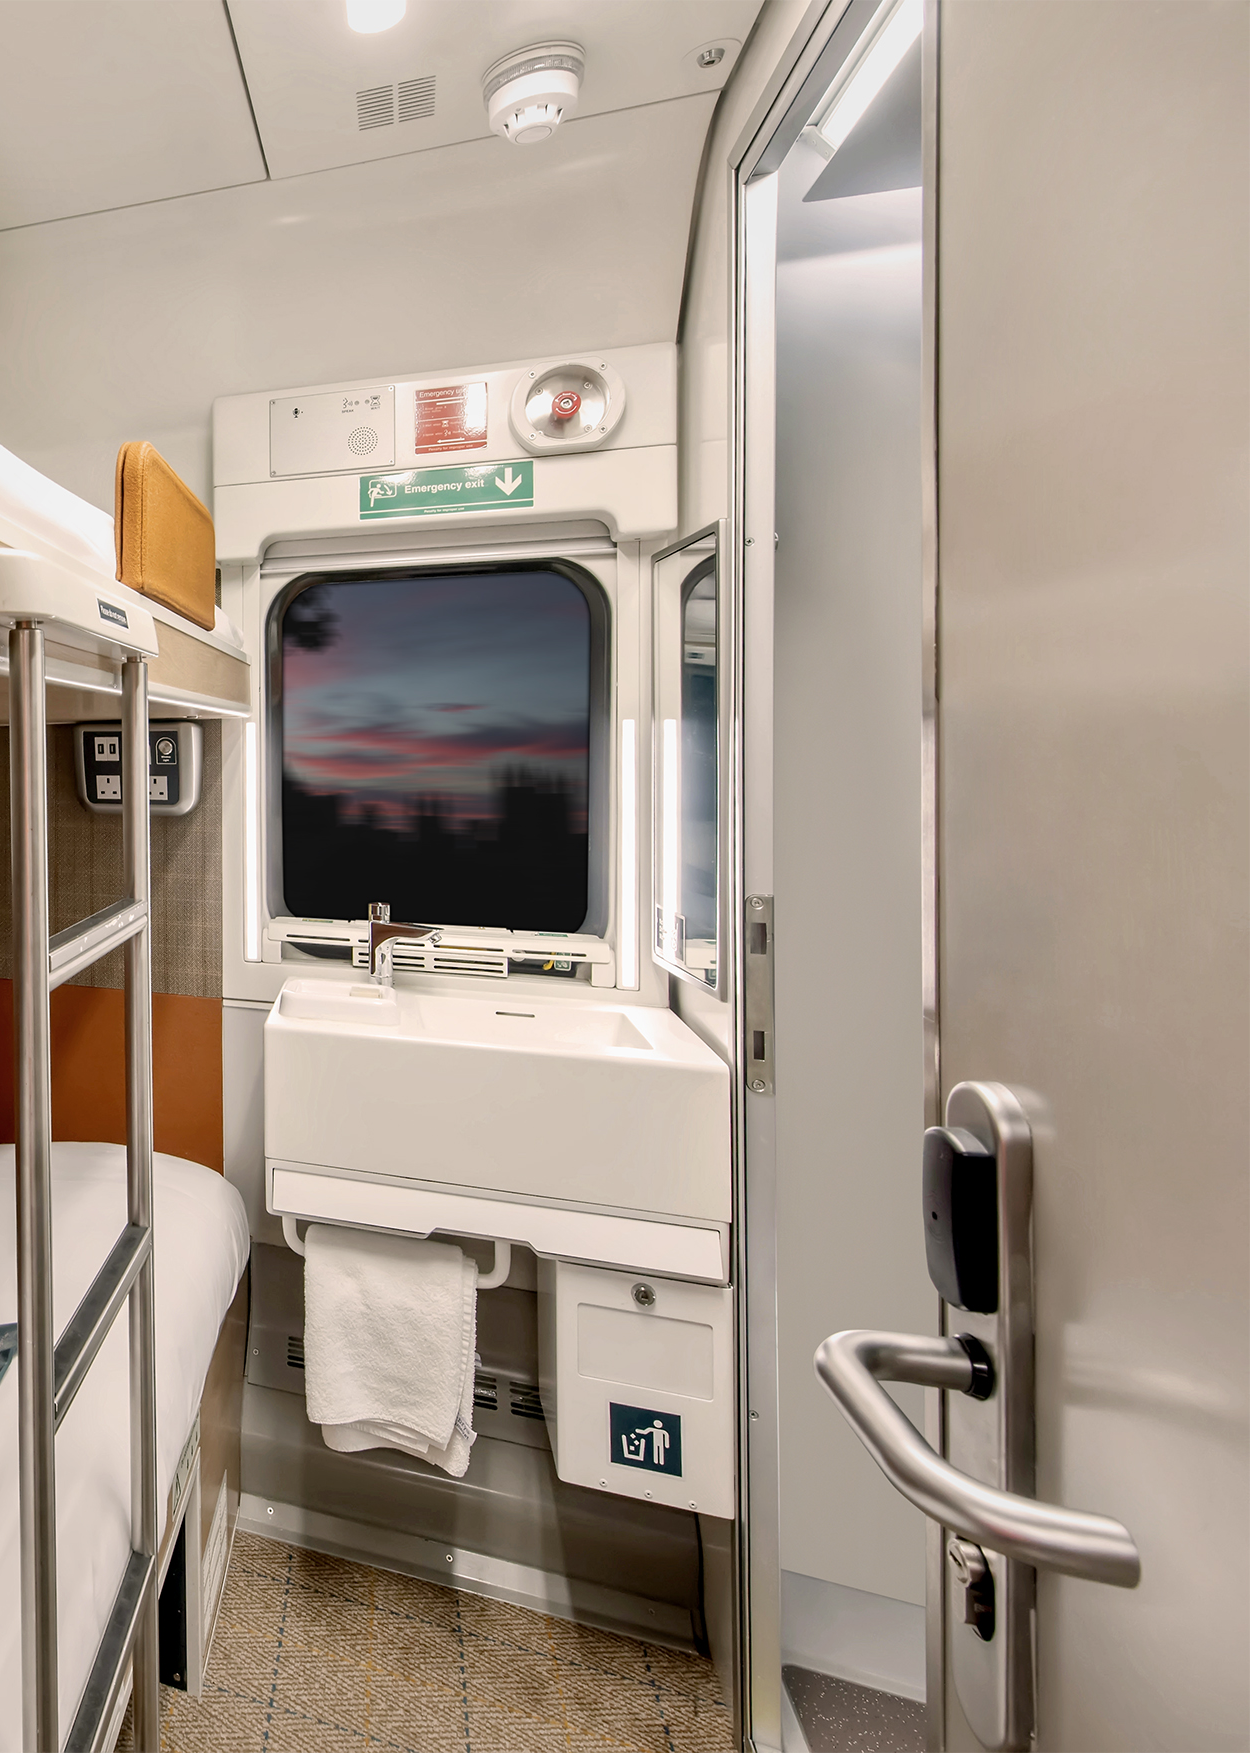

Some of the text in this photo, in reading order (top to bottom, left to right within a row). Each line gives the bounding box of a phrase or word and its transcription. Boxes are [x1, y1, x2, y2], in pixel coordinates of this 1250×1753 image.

[419, 389, 454, 398] Emergency
[404, 480, 484, 494] Emergency exit
